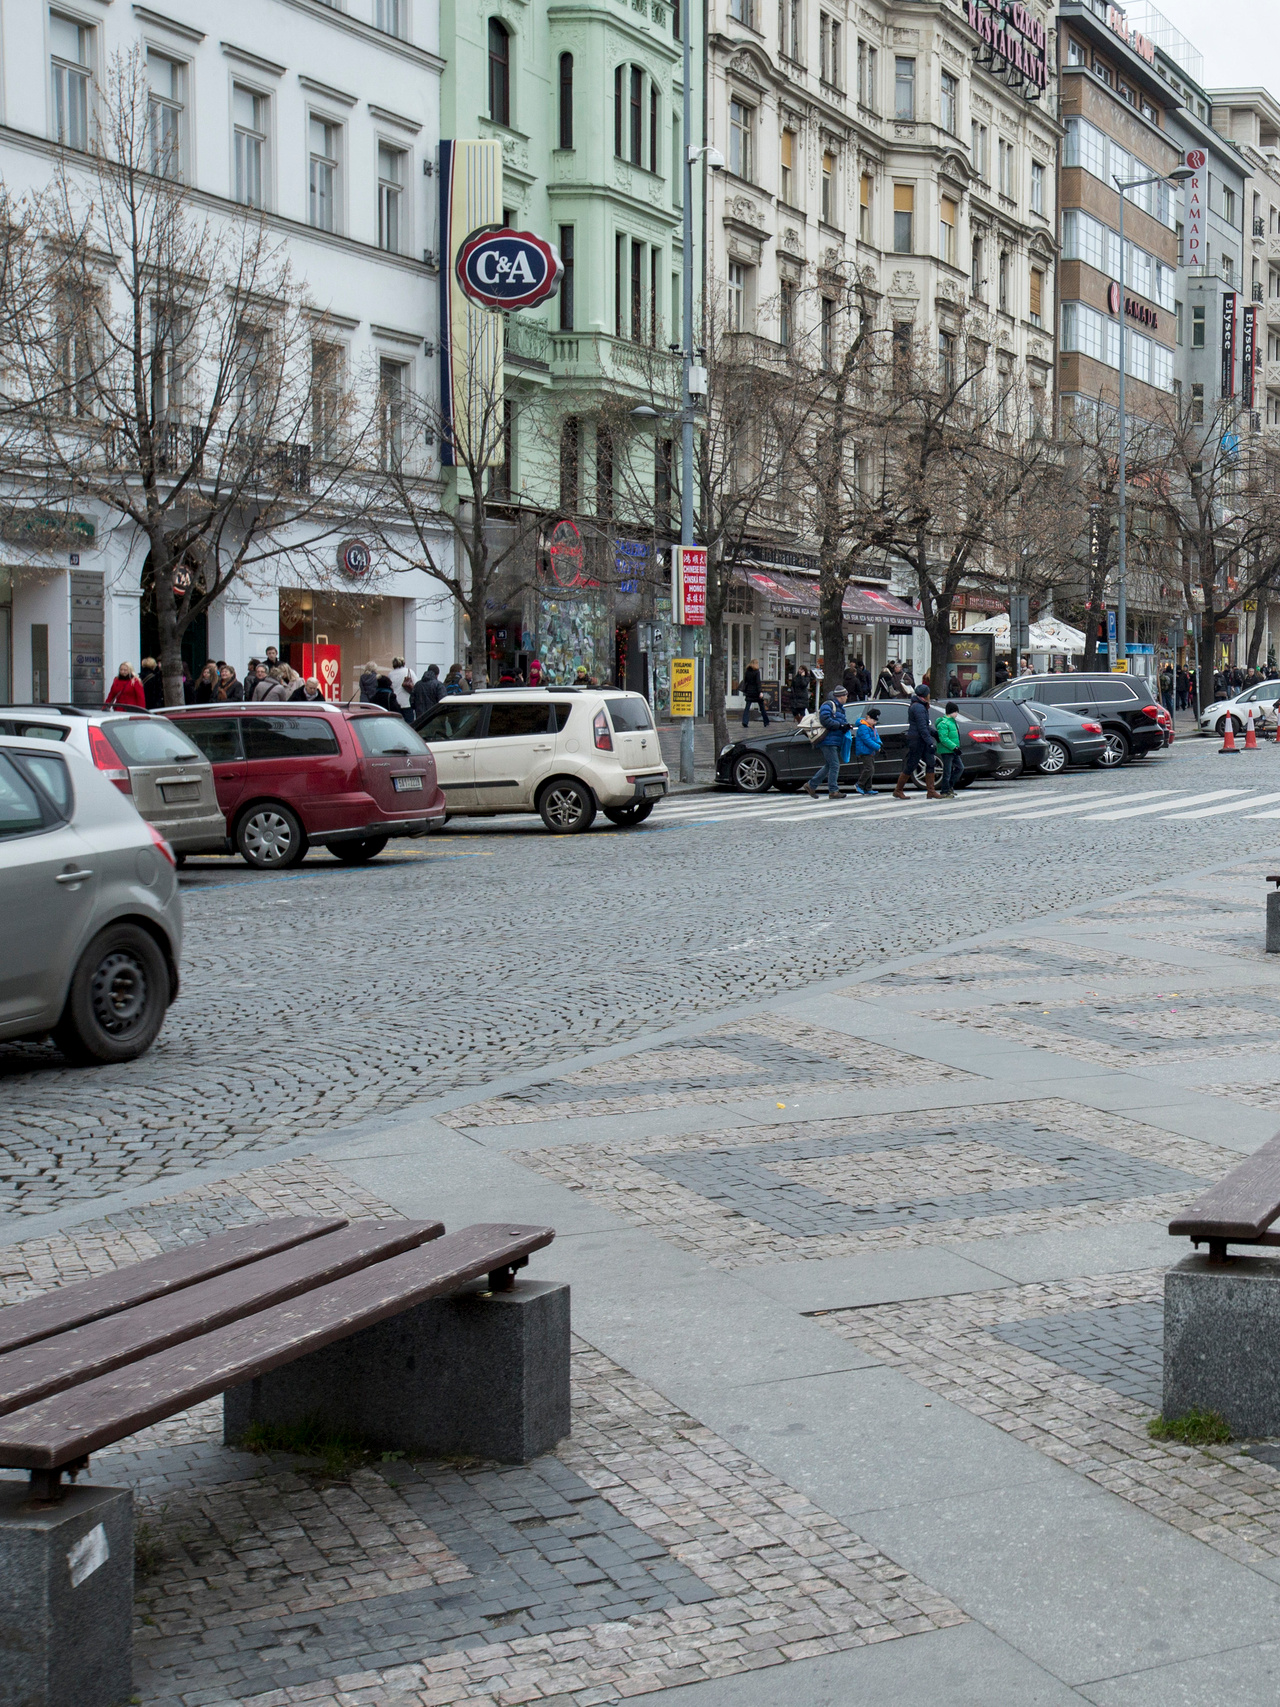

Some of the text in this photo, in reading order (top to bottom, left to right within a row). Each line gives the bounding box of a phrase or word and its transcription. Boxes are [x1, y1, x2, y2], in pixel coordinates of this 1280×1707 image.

[968, 0, 1043, 88] RESTAURANT
[1013, 2, 1044, 51] CZECH
[1188, 178, 1201, 265] RAMADA
[476, 250, 537, 284] C&A
